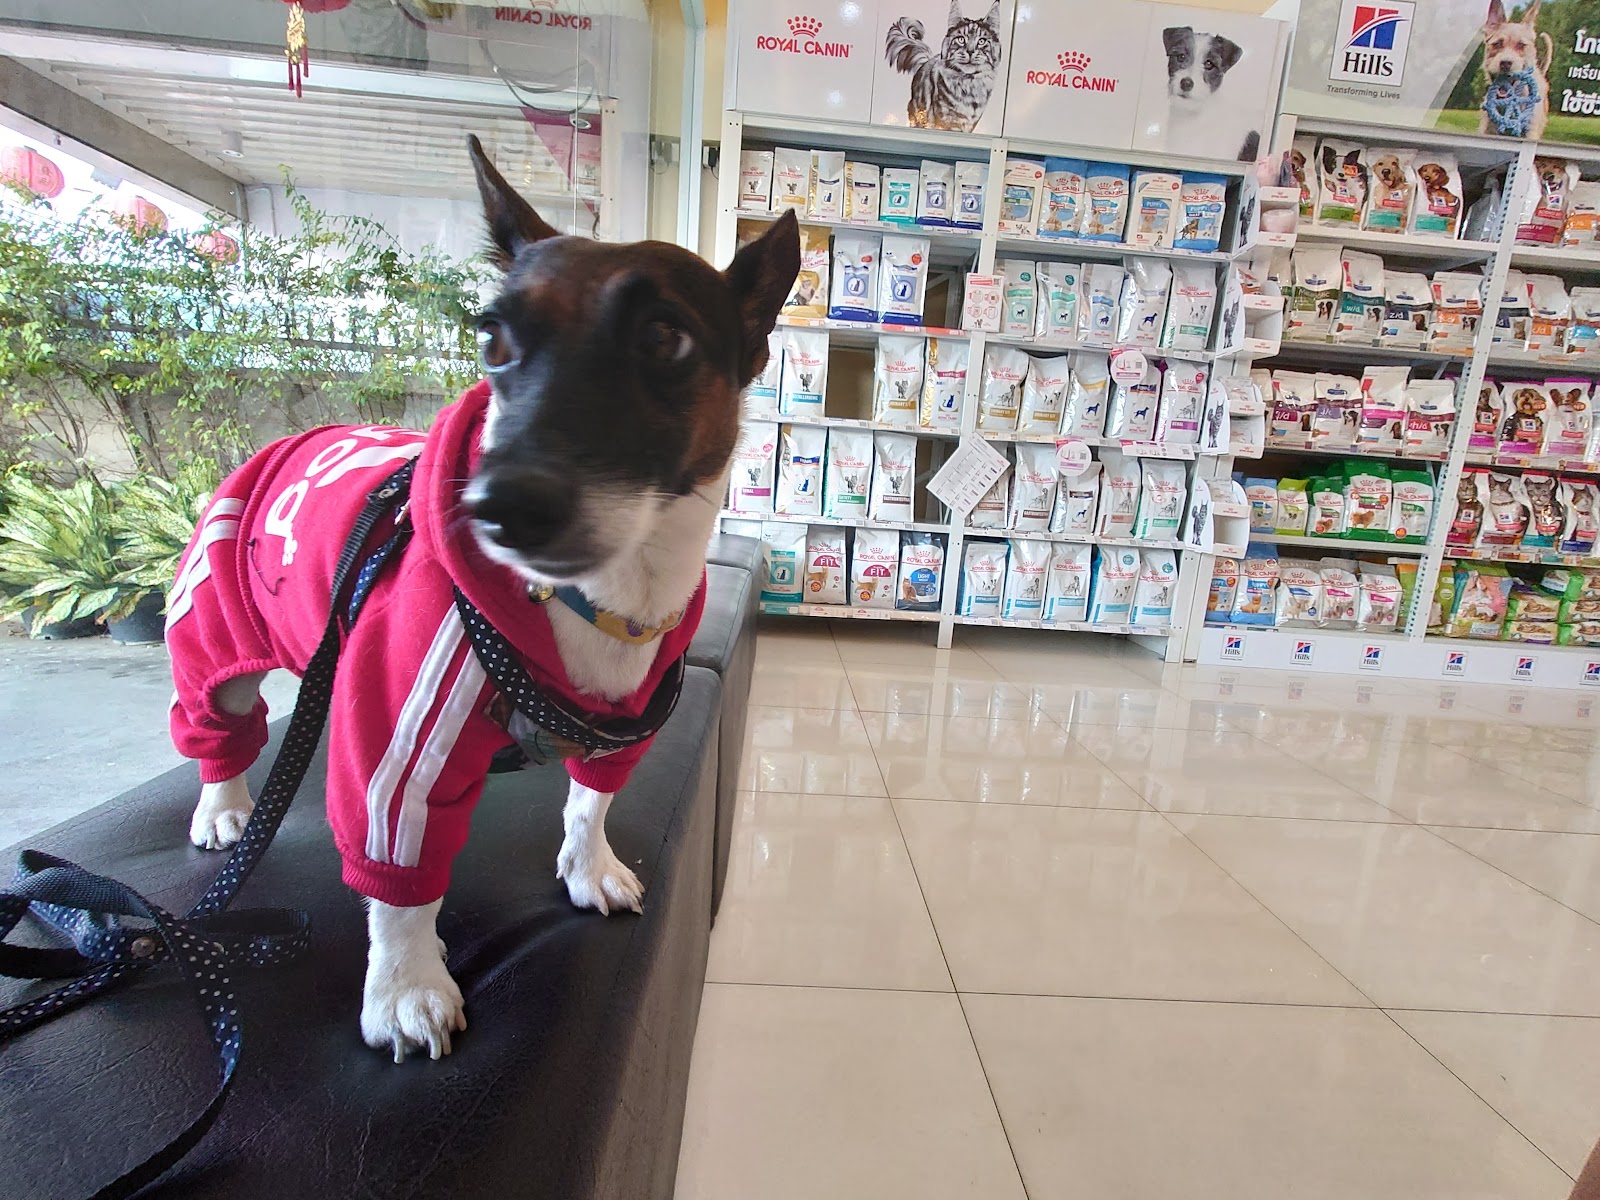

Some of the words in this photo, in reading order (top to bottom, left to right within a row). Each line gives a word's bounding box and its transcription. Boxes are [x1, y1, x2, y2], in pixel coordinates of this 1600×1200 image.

[757, 35, 800, 54] ROYAL
[804, 39, 850, 58] CANIN
[1342, 51, 1394, 77] Hill's
[1026, 70, 1069, 89] ROYAL
[1071, 75, 1117, 93] CANIN
[1326, 84, 1379, 98] Transforming
[1379, 89, 1401, 100] Lives
[1389, 311, 1404, 319] z/d
[820, 558, 834, 566] FIT
[870, 568, 886, 576] FIT
